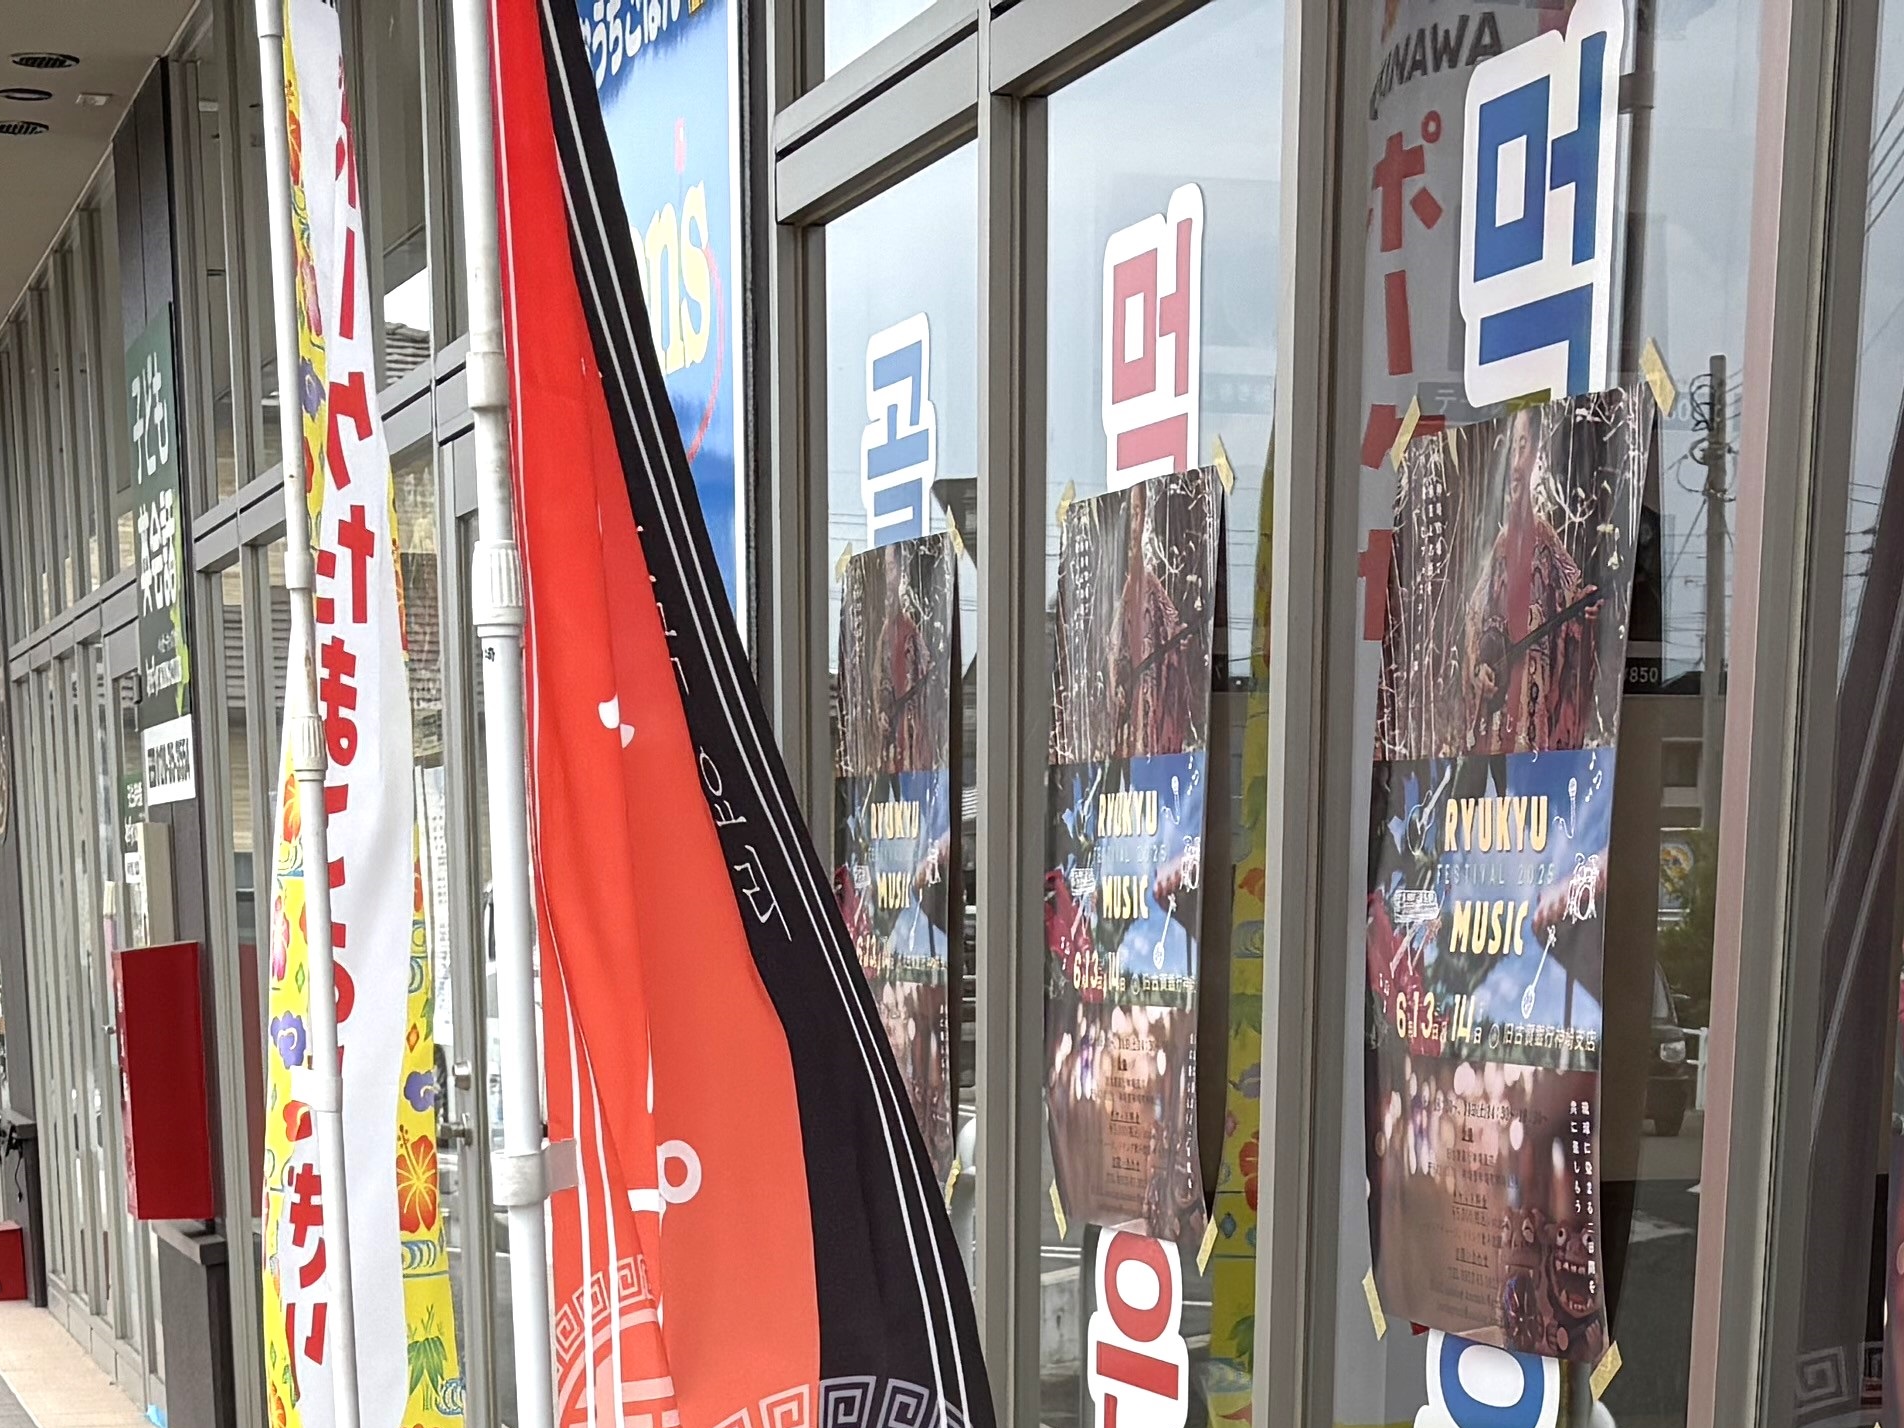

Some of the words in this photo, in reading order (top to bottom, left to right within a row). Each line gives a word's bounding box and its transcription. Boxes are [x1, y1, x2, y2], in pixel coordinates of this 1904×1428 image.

[870, 800, 920, 840] RYUKYU
[1097, 789, 1159, 837] RYUKYU
[1444, 796, 1548, 852] RYUKYU
[876, 871, 912, 909] MUSIC
[1102, 875, 1150, 919] MUSIC
[1448, 900, 1529, 956] MUSIC
